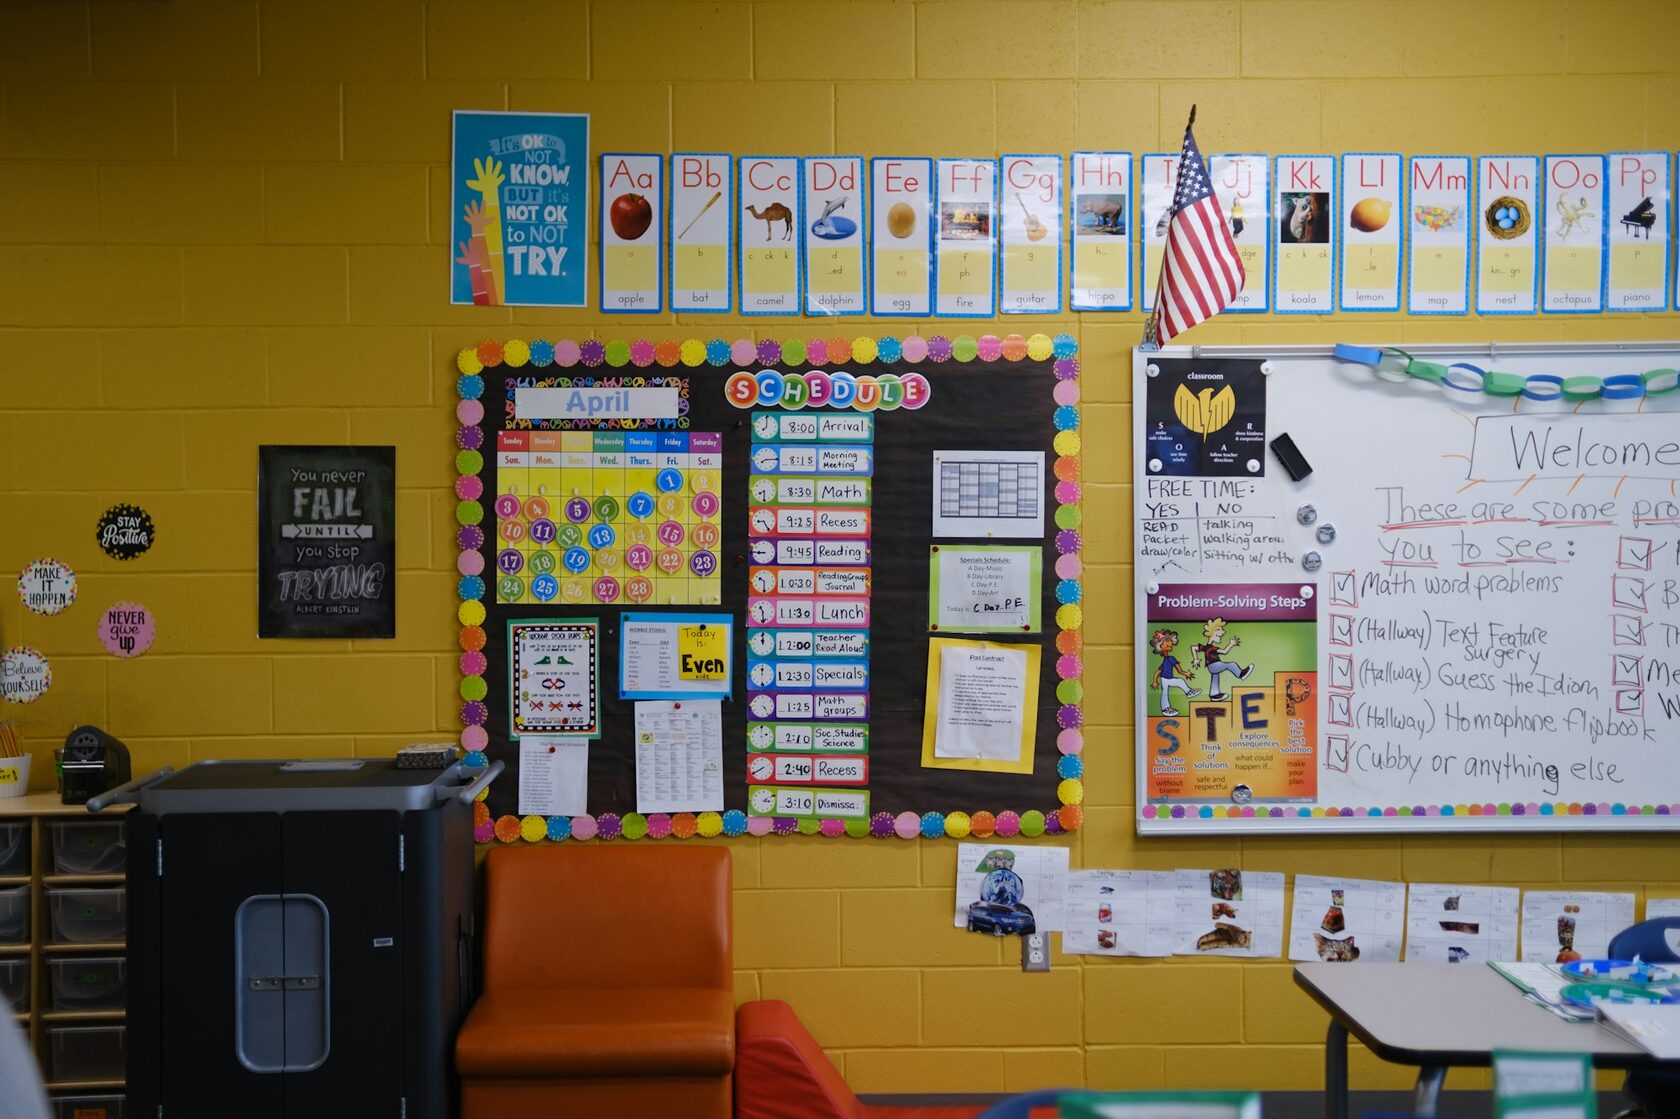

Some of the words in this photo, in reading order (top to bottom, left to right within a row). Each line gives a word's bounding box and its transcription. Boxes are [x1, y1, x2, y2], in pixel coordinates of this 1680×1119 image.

[499, 138, 520, 152] It's
[521, 135, 544, 148] OK
[546, 137, 556, 147] to
[525, 151, 550, 164] NOT
[510, 164, 571, 187] KNOW,
[609, 159, 653, 189] Aa
[682, 159, 721, 188] Bb
[748, 162, 791, 191] Cc
[813, 162, 854, 190] Dd
[886, 163, 918, 192] Ee
[951, 165, 986, 192] Ff
[1082, 158, 1122, 187] Hh
[1223, 160, 1252, 198] Jj
[1291, 161, 1321, 189] Kk
[1360, 159, 1384, 187] Ll
[1414, 162, 1466, 190] Mm
[1489, 161, 1528, 190] Nn
[1552, 160, 1598, 189] Oo
[1621, 158, 1657, 197] Pp
[1008, 160, 1053, 202] Gg
[508, 189, 539, 201] BUT
[548, 189, 570, 201] it's
[507, 206, 538, 221] NOT
[544, 206, 567, 221] OK
[507, 226, 525, 242] to
[529, 226, 568, 243] NOT
[507, 246, 567, 277] TRY.
[618, 294, 644, 307] apple
[692, 293, 709, 302] bat
[757, 296, 784, 305] camel
[818, 295, 854, 307] dolphin
[956, 297, 973, 307] fire
[1016, 294, 1045, 304] guitar
[1088, 290, 1114, 302] hippo
[1291, 294, 1316, 304] koala
[1356, 293, 1384, 302] lemon
[1429, 296, 1448, 305] map
[1496, 295, 1517, 304] nest
[1553, 295, 1592, 306] octopus
[1624, 293, 1650, 304] piano
[893, 300, 910, 310] egg
[1188, 372, 1223, 380] classroom
[736, 379, 917, 403] SCHEDULE
[566, 390, 630, 416] April
[789, 422, 815, 433] 8:00
[823, 420, 864, 432] Arrival
[503, 438, 522, 446] Sunday
[664, 438, 681, 446] Friday
[693, 438, 717, 446] Saturday
[1511, 425, 1680, 470] Welcome
[505, 456, 521, 464] Sun.
[667, 457, 678, 465] Fri.
[698, 457, 712, 465] Sat.
[790, 456, 813, 465] 8:15
[823, 452, 857, 461] Morning
[823, 461, 855, 470] Meeting
[290, 468, 317, 483] You
[321, 470, 365, 483] never
[787, 486, 812, 496] 8:30
[822, 486, 862, 499] Math
[1148, 480, 1192, 498] FREE
[1200, 481, 1255, 498] TIME:
[293, 487, 362, 520] FAIL
[637, 500, 645, 511] 7
[1146, 503, 1179, 518] YES
[1217, 503, 1242, 515] NO
[1375, 487, 1466, 523] These
[1471, 502, 1515, 520] are
[1531, 501, 1616, 520] some
[118, 517, 141, 527] STAY
[787, 517, 812, 527] 9:25
[821, 514, 858, 527] Recess
[1144, 523, 1178, 532] READ
[1204, 520, 1253, 535] talking
[102, 527, 149, 546] Positive
[305, 527, 351, 536] UNTIL
[535, 524, 550, 538] 11
[594, 530, 610, 544] 13
[1144, 535, 1189, 544] Packet
[296, 545, 322, 562] you
[327, 545, 360, 562] stop
[787, 548, 812, 557] 9:45
[819, 543, 861, 559] Reading
[1378, 537, 1434, 576] you
[1452, 529, 1481, 563] to
[632, 552, 647, 563] 21
[695, 557, 711, 569] 23
[33, 568, 61, 579] MAKE
[41, 581, 53, 592] IT
[278, 563, 385, 600] TRYING
[538, 581, 553, 594] 25
[781, 579, 812, 587] 10:30
[825, 582, 856, 591] Journal
[1362, 571, 1416, 597] Math
[1425, 573, 1469, 593] word
[1474, 568, 1563, 599] problems
[29, 593, 66, 606] HAPPEN
[1158, 596, 1267, 609] Problem-Solving
[1271, 596, 1306, 609] Steps
[108, 611, 144, 625] NEVER
[780, 608, 810, 618] 11:30
[822, 605, 864, 620] Lunch
[110, 624, 140, 639] give
[683, 628, 715, 639] Today
[1357, 611, 1431, 651] (Hallway)
[1435, 620, 1480, 647] Text
[1489, 622, 1547, 648] Feature
[119, 638, 135, 653] up
[2, 662, 43, 676] Believe
[682, 654, 724, 673] Even
[817, 668, 863, 682] Specials
[1359, 657, 1431, 694] (Hallway)
[1438, 663, 1495, 691] Guess
[1503, 673, 1534, 696] the
[1, 680, 45, 693] YOURSELF
[818, 697, 845, 705] Math
[824, 707, 856, 717] groups
[1356, 699, 1435, 740] (Hallway)
[1446, 701, 1557, 737] Homophone
[1563, 708, 1656, 744] flipbook
[819, 762, 857, 776] Recess
[1356, 741, 1422, 784] Cubby
[1432, 754, 1457, 774] or
[1464, 752, 1559, 796] anything
[1570, 756, 1624, 783] else
